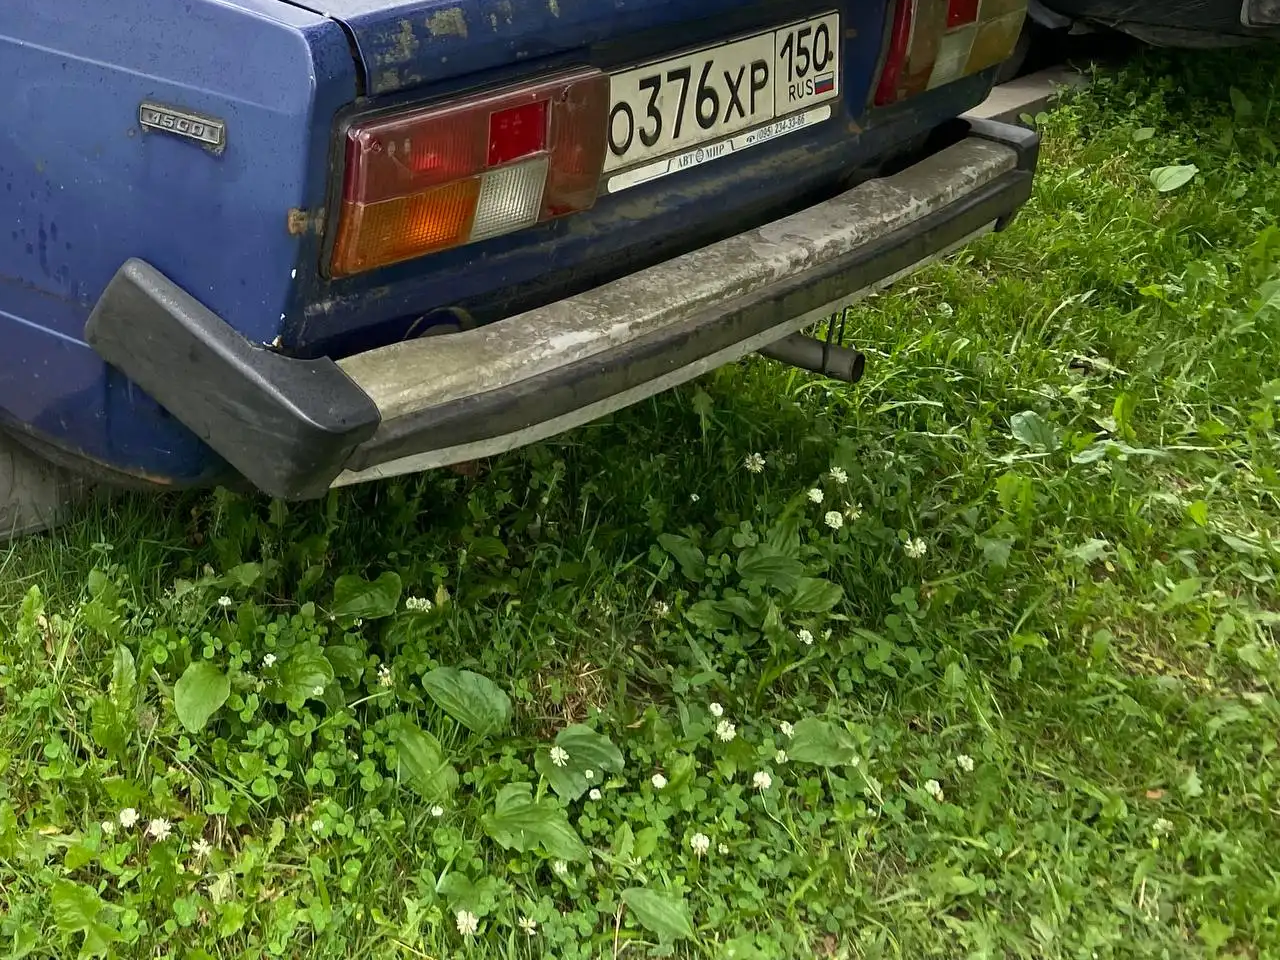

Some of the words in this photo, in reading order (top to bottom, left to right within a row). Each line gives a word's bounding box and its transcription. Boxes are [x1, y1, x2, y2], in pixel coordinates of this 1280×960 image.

[780, 22, 830, 83] 150
[609, 59, 769, 157] О376ХР
[788, 78, 814, 104] RUS
